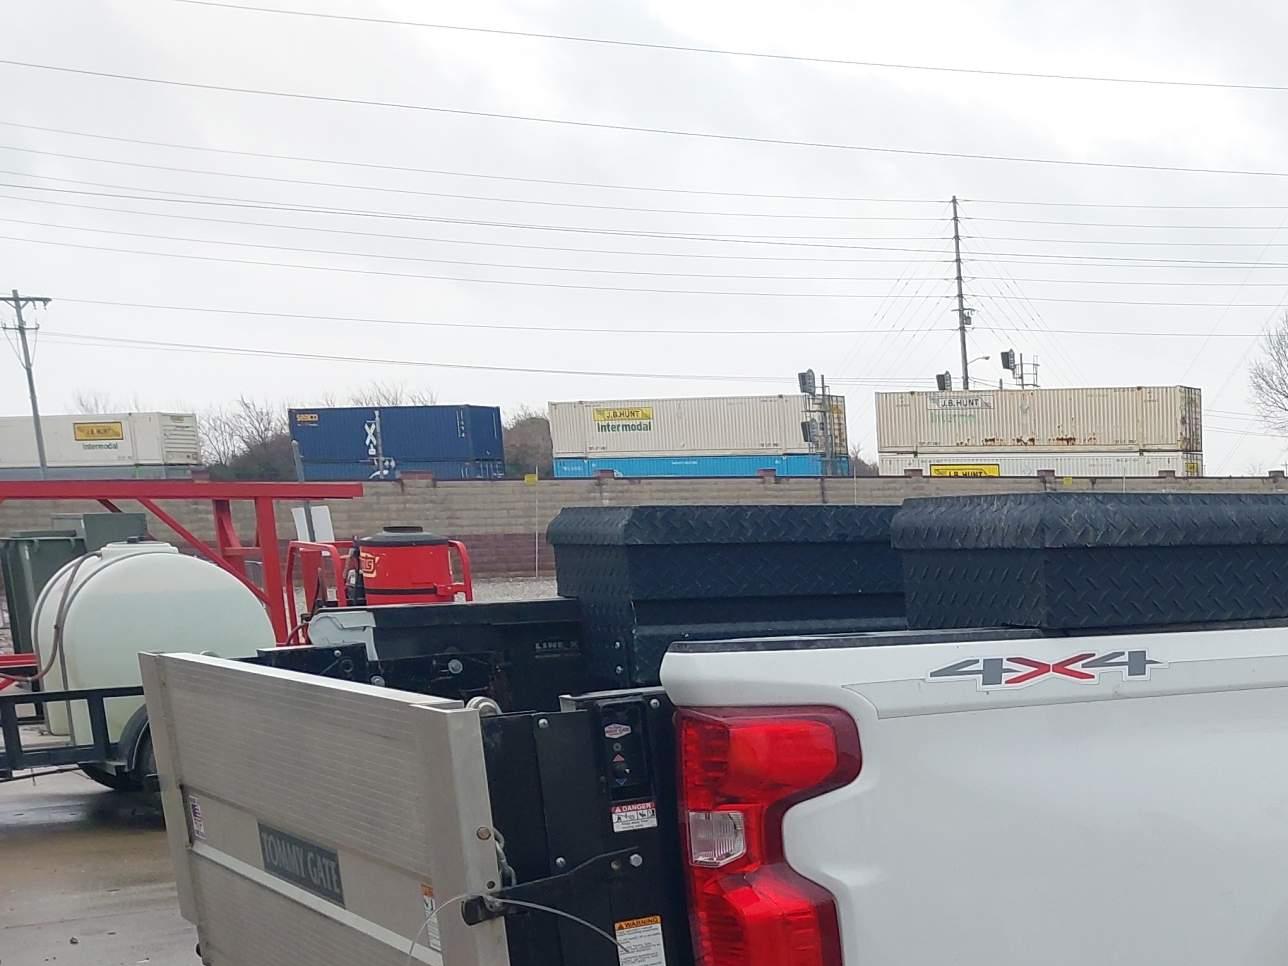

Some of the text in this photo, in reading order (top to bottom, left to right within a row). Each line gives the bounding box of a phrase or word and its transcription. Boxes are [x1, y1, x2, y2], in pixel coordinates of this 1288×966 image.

[597, 421, 652, 433] Intermodal
[622, 801, 652, 812] DANGER
[260, 831, 341, 893] TOMMY GATE
[624, 917, 659, 928] WARNING
